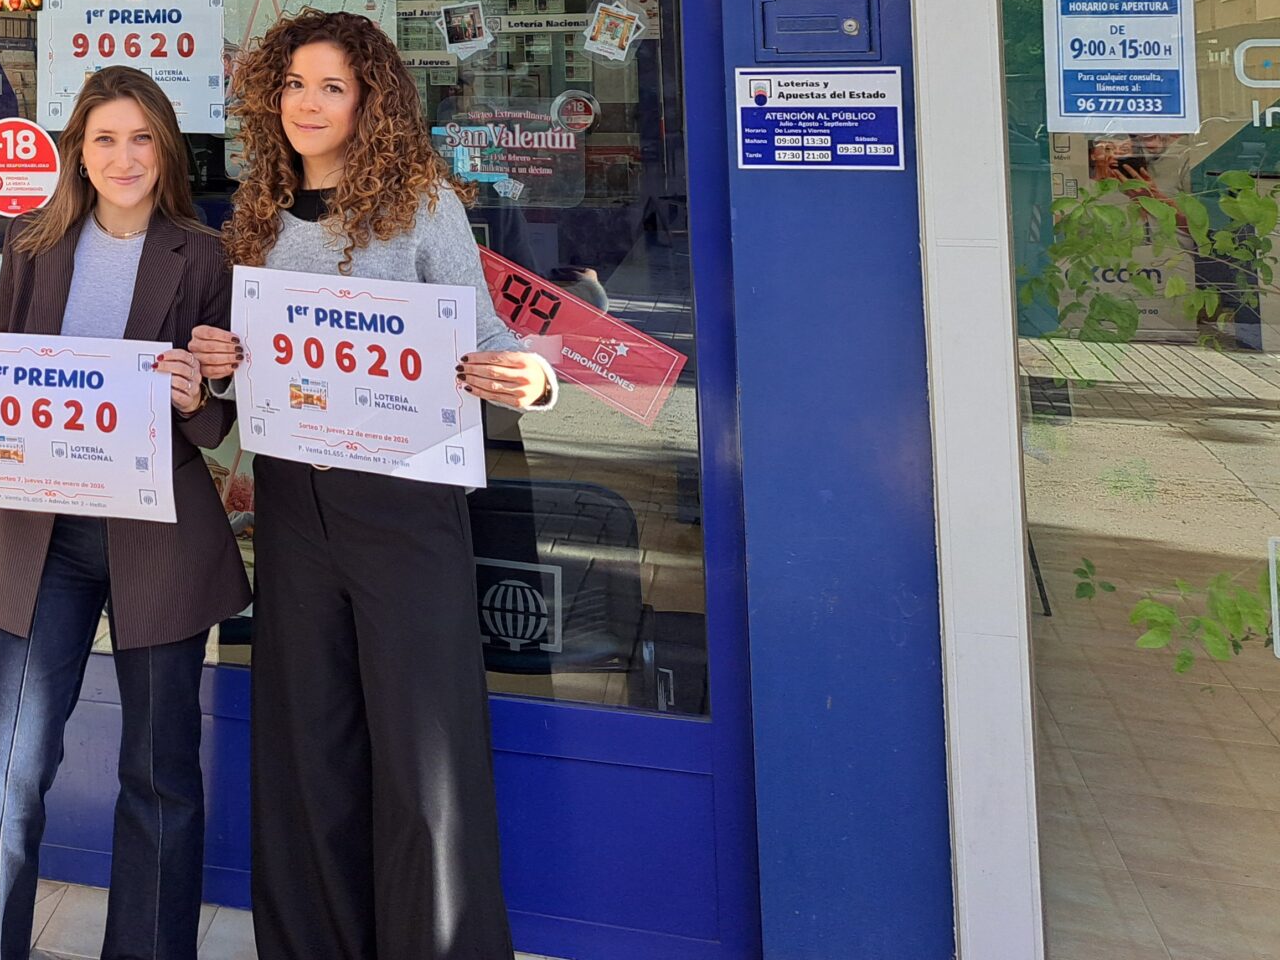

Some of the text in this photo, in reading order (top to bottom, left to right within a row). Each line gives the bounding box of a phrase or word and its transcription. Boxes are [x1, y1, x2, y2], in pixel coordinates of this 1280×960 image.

[1069, 1, 1169, 12] HORARIO DE APERTURA
[85, 8, 182, 25] 1er PREMIO
[508, 19, 588, 28] Lotería Nacional
[1110, 25, 1126, 36] DE
[72, 32, 195, 58] 90620
[1070, 39, 1172, 59] 9:00 A 15:00 H
[1078, 72, 1164, 84] Para cualquier consulta,
[778, 80, 829, 89] Loterías y
[1096, 82, 1141, 93] llámenos al:
[778, 91, 886, 101] Apuestas del Estado
[1077, 98, 1163, 112] 96 777 0333
[468, 109, 551, 122] Sorteo Extraordinario
[765, 111, 814, 120] ATENCIÓN
[832, 111, 876, 120] PÚBLICO
[445, 122, 576, 150] San Valentín
[507, 154, 531, 162] febrero
[777, 146, 892, 160] 17:30 21:00 09:30 13:30
[528, 166, 552, 174] décimo
[287, 305, 405, 335] 1er PREMIO
[272, 333, 422, 381] 90620
[561, 346, 635, 392] EUROMILLONES
[14, 367, 104, 390] PREMIO
[374, 393, 409, 404] LOTERÍA
[374, 401, 418, 413] NACIONAL
[299, 423, 318, 431] Sorteo
[326, 427, 345, 435] jueves
[393, 436, 409, 444] 2026
[70, 445, 104, 454] LOTERÍA
[71, 453, 114, 462] NACIONAL
